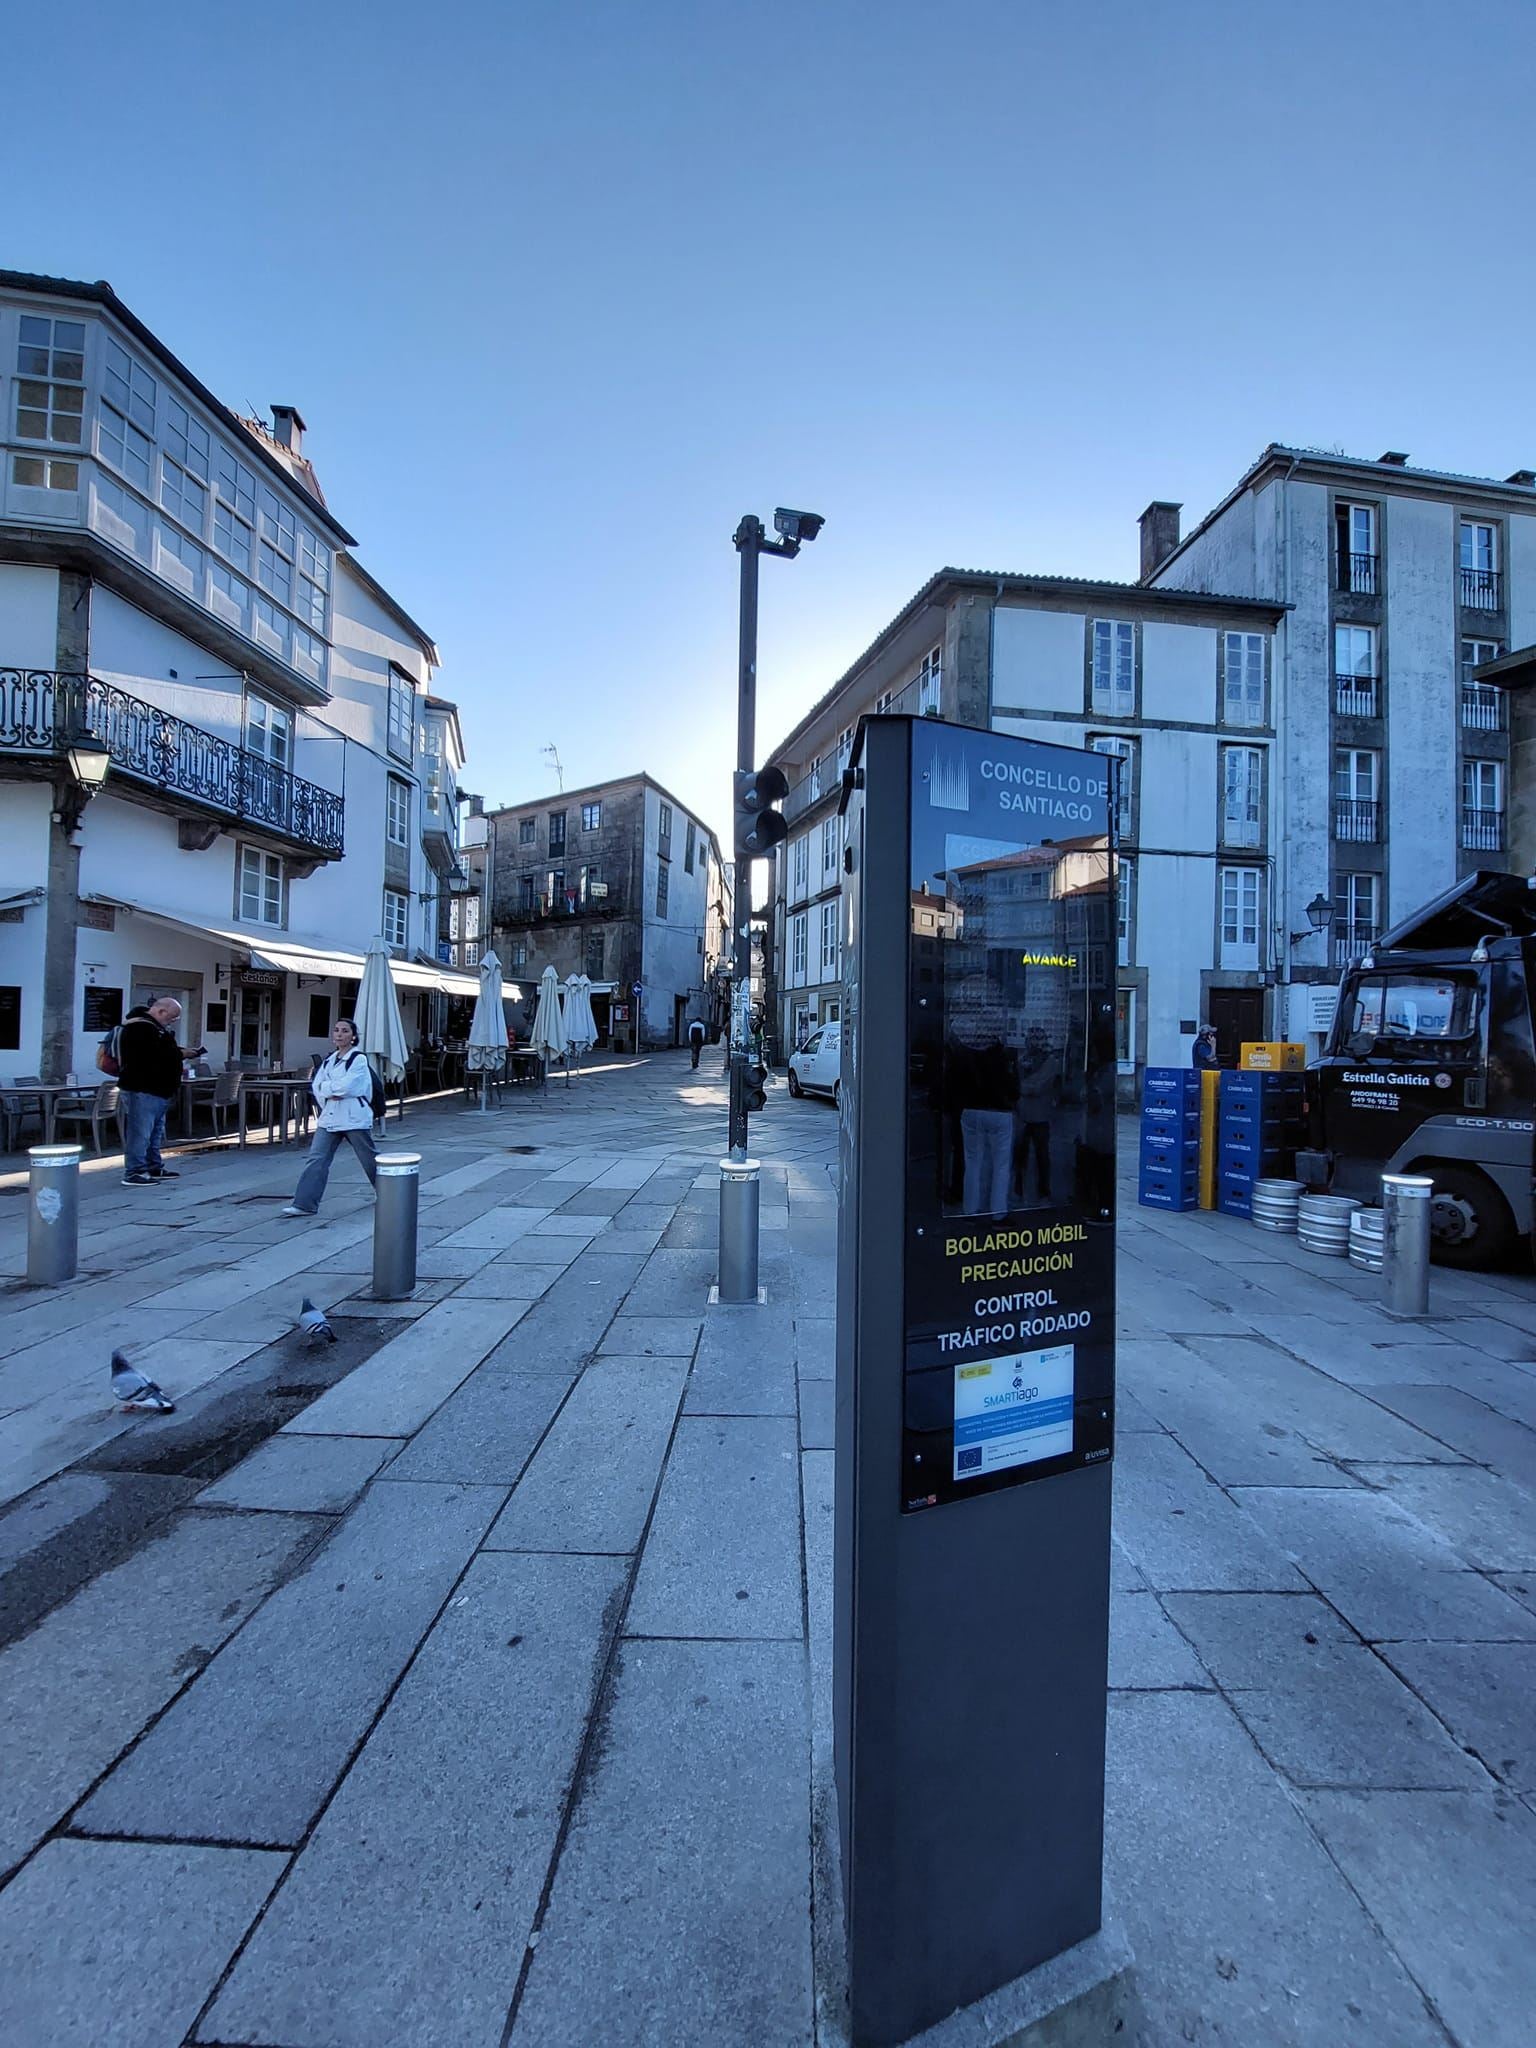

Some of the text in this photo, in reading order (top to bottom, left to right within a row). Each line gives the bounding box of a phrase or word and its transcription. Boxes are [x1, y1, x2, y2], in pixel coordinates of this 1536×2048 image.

[980, 759, 1108, 799] CONCELLO DE
[999, 790, 1093, 822] SANTIAGO
[1022, 952, 1077, 968] AVANCE
[1342, 1072, 1430, 1086] Estrella Galicia
[945, 1223, 1088, 1257] BOLARDO MÓBIL
[961, 1251, 1074, 1284] PRECAUCIÓN
[974, 1289, 1058, 1317] CONTROL
[937, 1310, 1092, 1352] TRÁFICO RODADO
